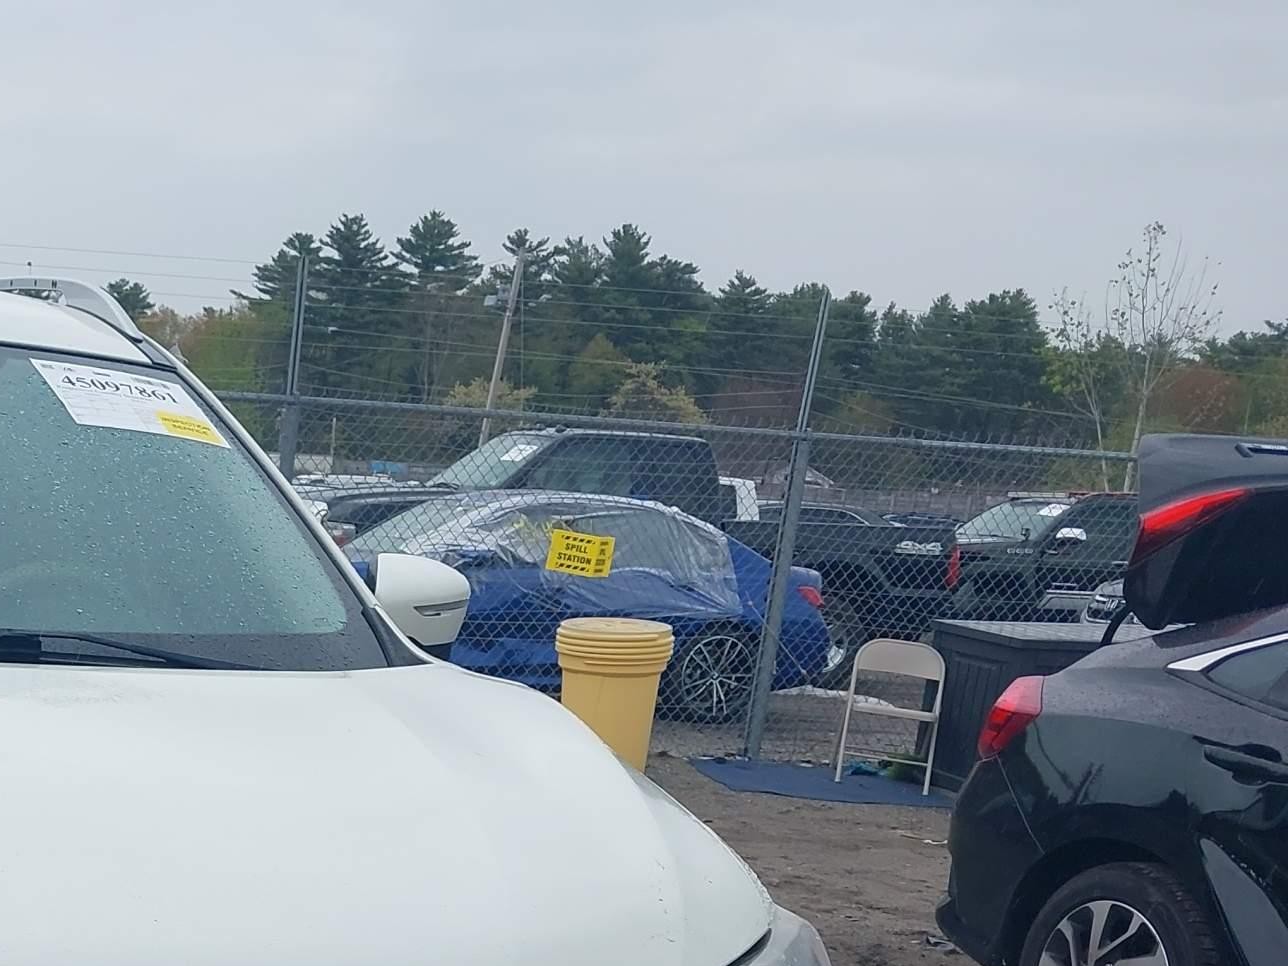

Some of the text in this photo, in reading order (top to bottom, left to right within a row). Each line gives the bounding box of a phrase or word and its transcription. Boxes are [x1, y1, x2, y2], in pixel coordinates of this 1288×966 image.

[62, 375, 178, 404] 45097861
[564, 542, 588, 554] SPILL
[556, 551, 592, 565] STATION
